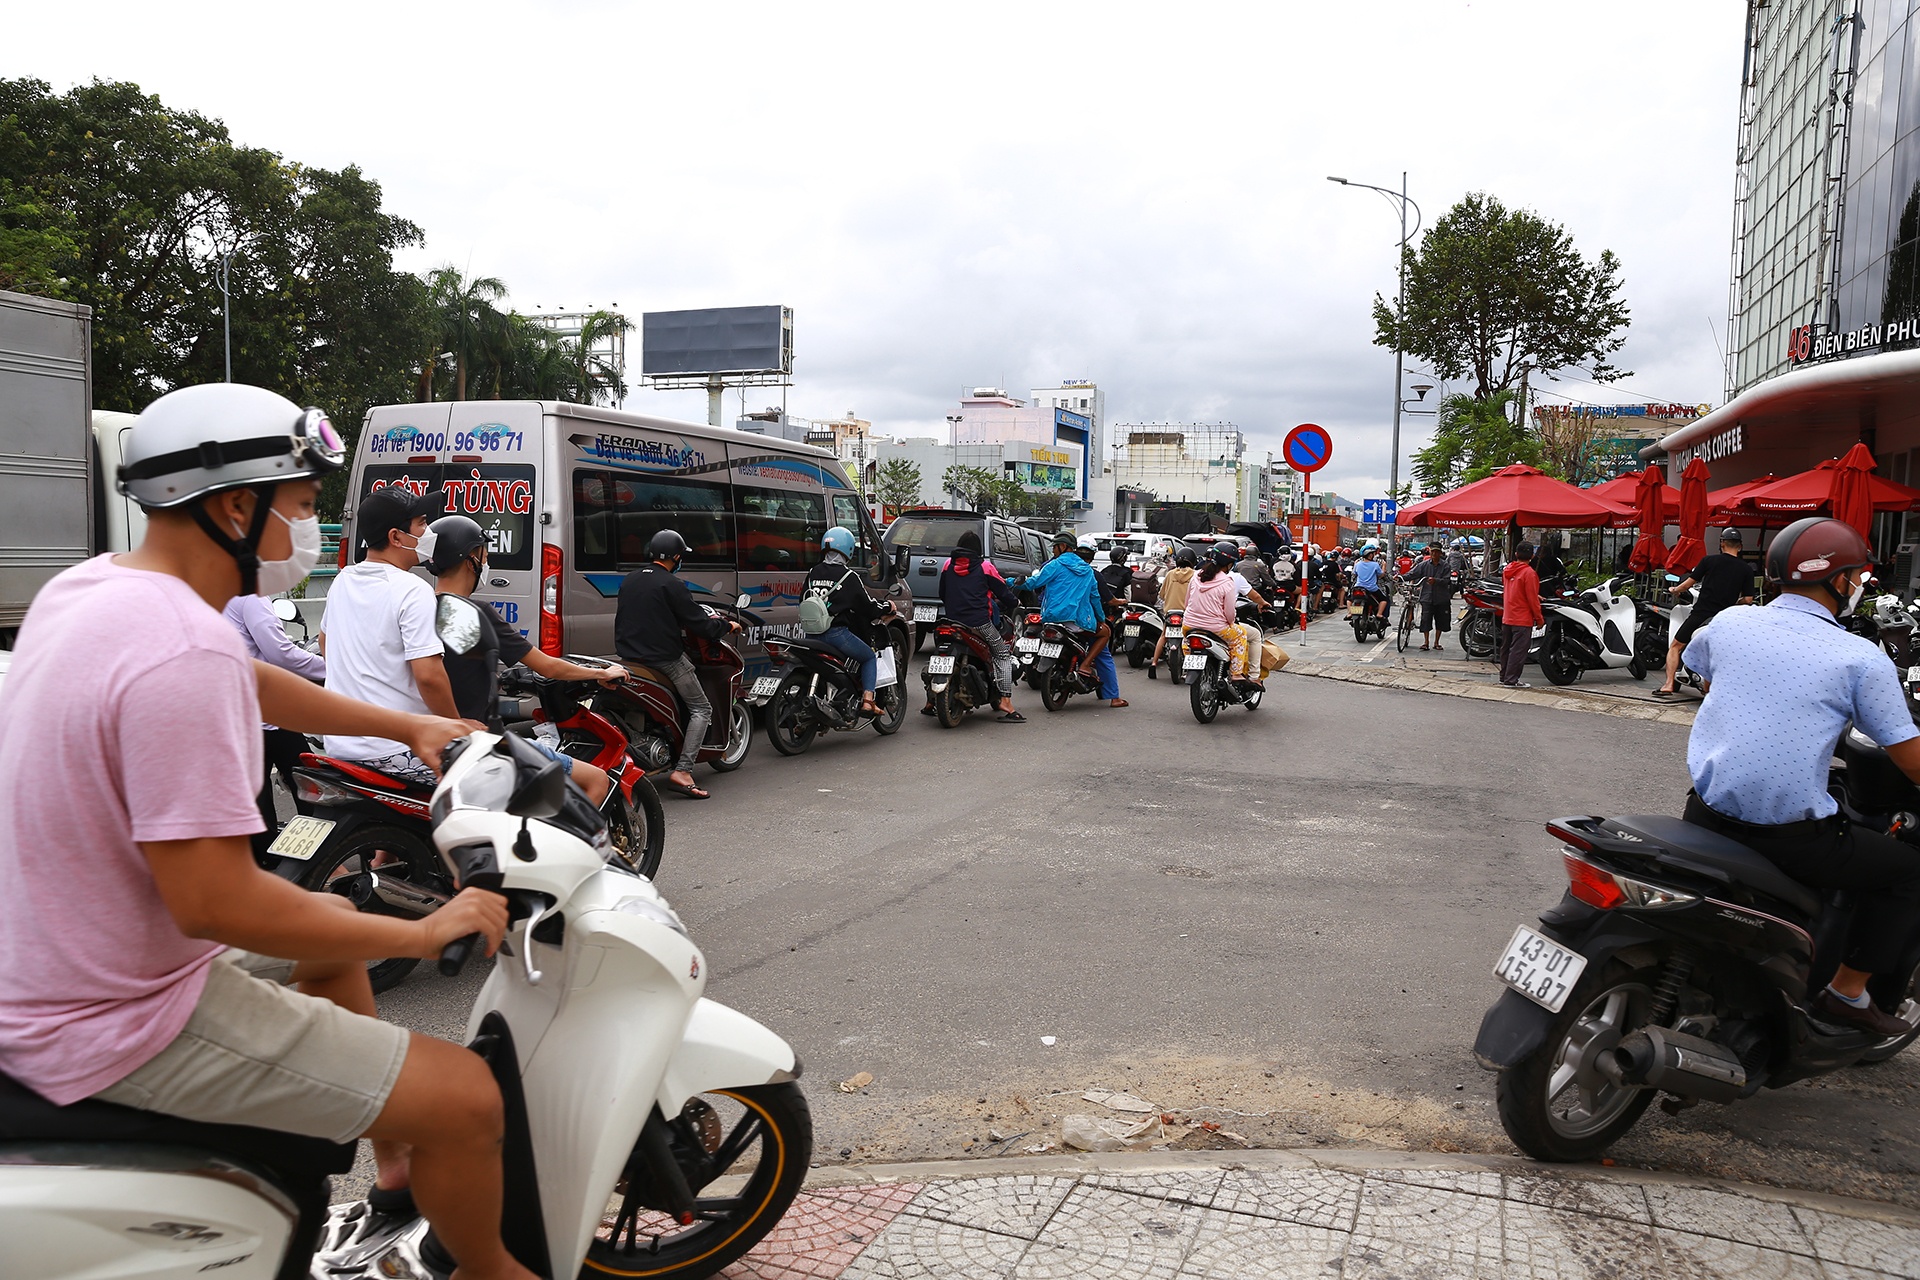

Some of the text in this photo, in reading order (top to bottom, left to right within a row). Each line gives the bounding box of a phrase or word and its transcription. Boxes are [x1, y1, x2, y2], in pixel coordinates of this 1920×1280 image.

[1787, 324, 1811, 363] 46
[1814, 331, 1843, 358] ĐIỆN
[1846, 322, 1882, 350] BIÊN
[371, 434, 388, 458] Đặt
[454, 431, 475, 452] 96
[479, 431, 501, 452] 96
[506, 431, 524, 452] 71
[598, 433, 674, 455] TRANSIT
[1030, 445, 1052, 462] TIẾN
[1712, 424, 1743, 460] COFFEE
[441, 467, 533, 514] TÙNG
[747, 626, 760, 646] XE
[288, 819, 328, 840] 43-T1
[1617, 830, 1643, 843] SYM
[275, 836, 315, 856] 9468
[1518, 934, 1573, 978] 43-D1
[1498, 955, 1568, 1006] 154.87
